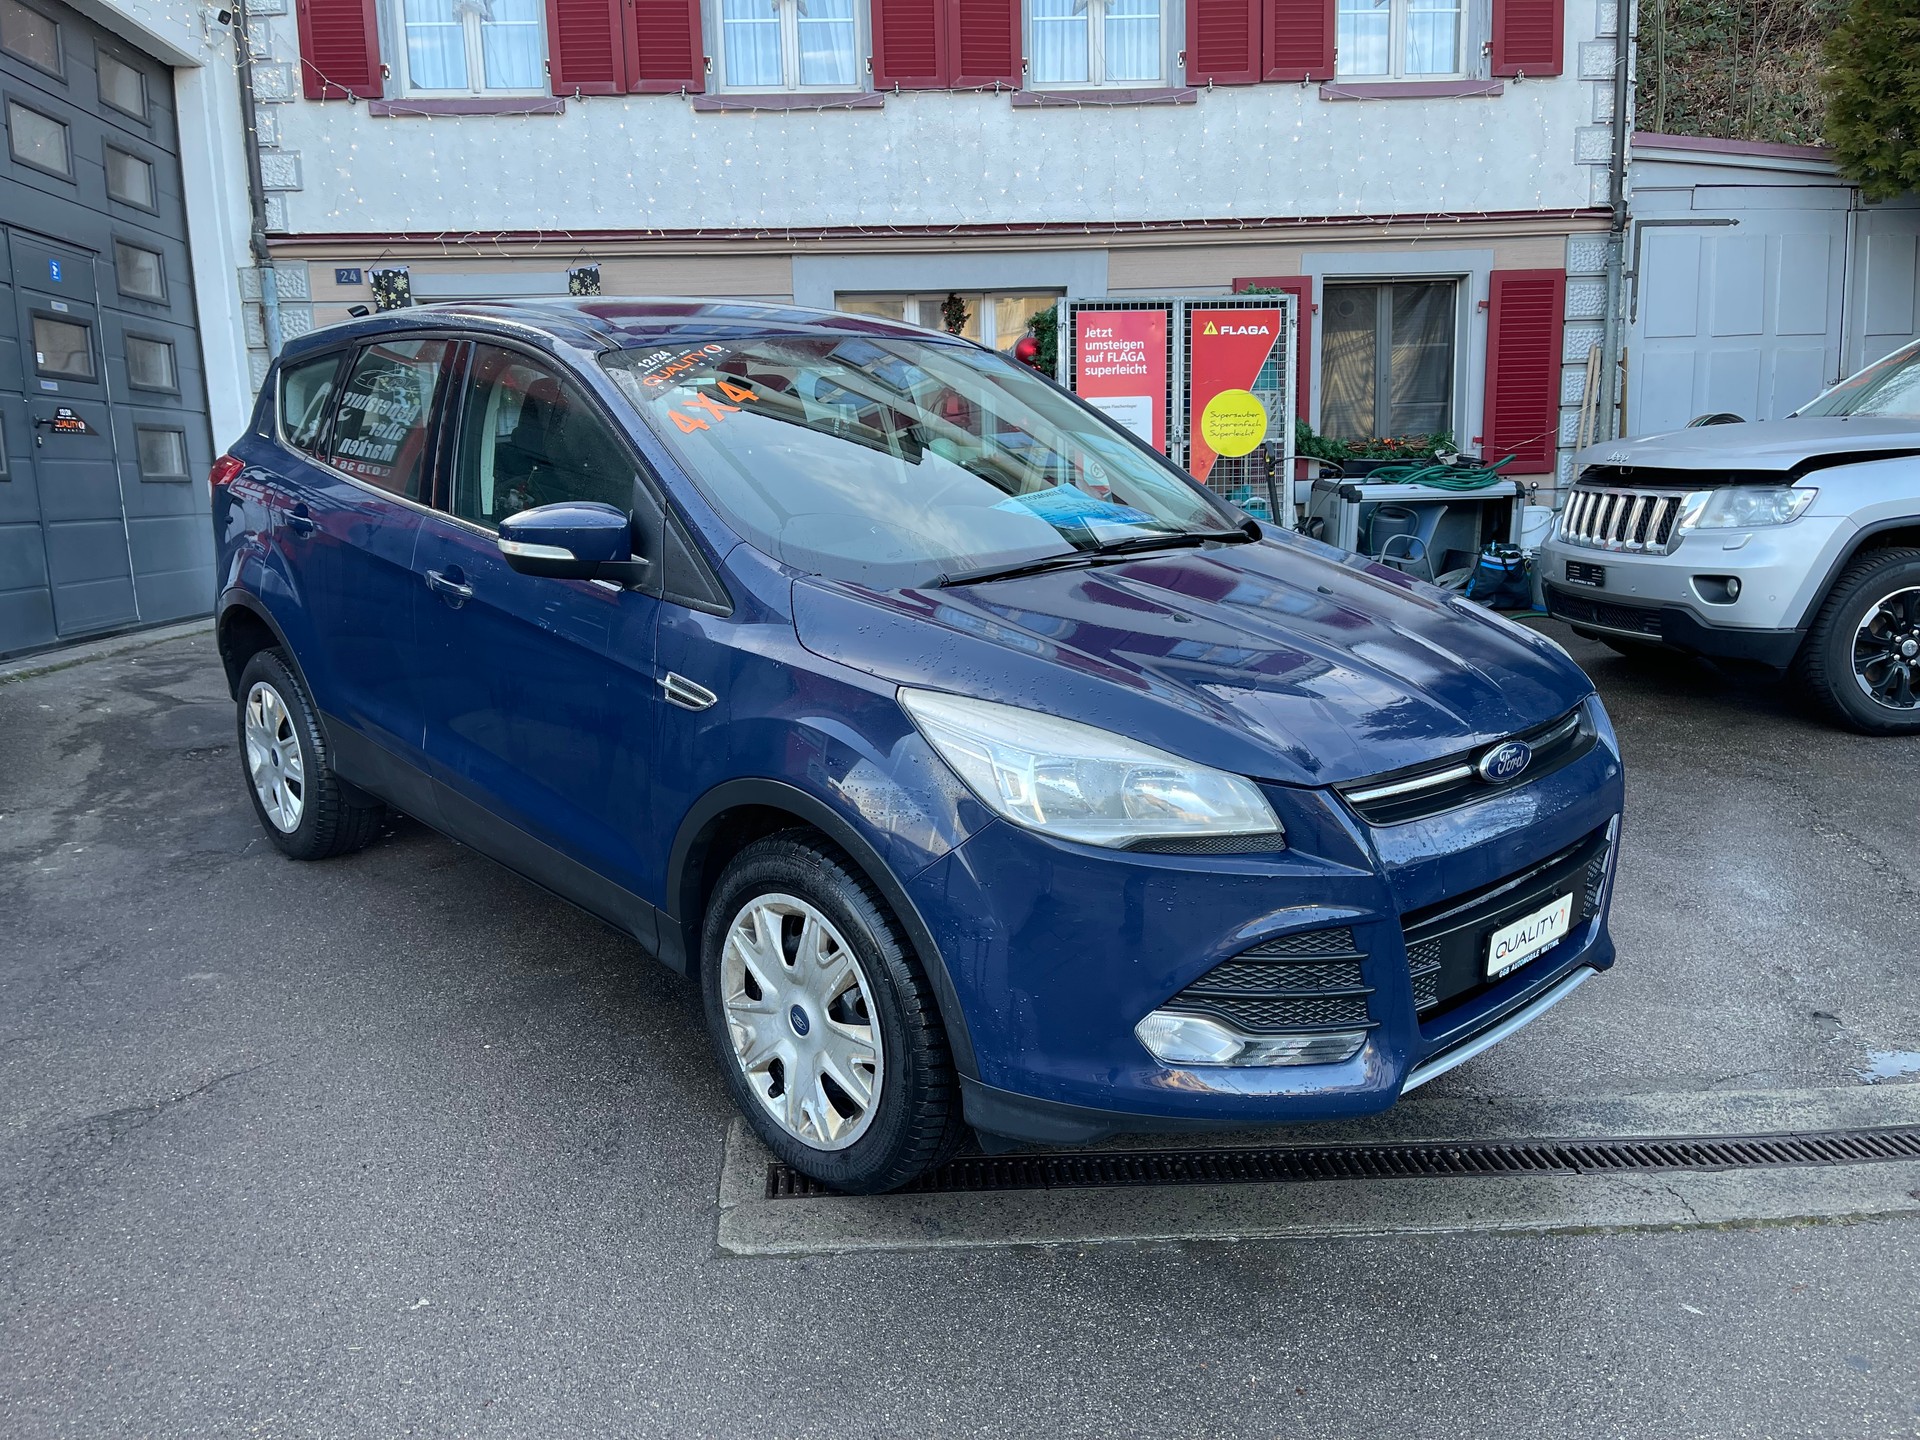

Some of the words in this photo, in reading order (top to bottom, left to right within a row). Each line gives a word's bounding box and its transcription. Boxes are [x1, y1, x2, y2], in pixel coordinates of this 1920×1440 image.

[340, 270, 357, 282] 24
[1085, 327, 1113, 338] Jetzt
[1220, 325, 1270, 335] FLAGA
[1085, 339, 1145, 352] umsteigen
[637, 350, 672, 369] 12/24
[1085, 352, 1104, 363] auf
[1107, 351, 1146, 363] FLAGA
[642, 349, 708, 386] QUALITY
[1085, 364, 1148, 378] superleicht
[1210, 410, 1260, 421] Supersauber
[1209, 429, 1255, 440] Superleicht
[1497, 747, 1524, 775] Ford
[1495, 911, 1559, 960] QUALITY
